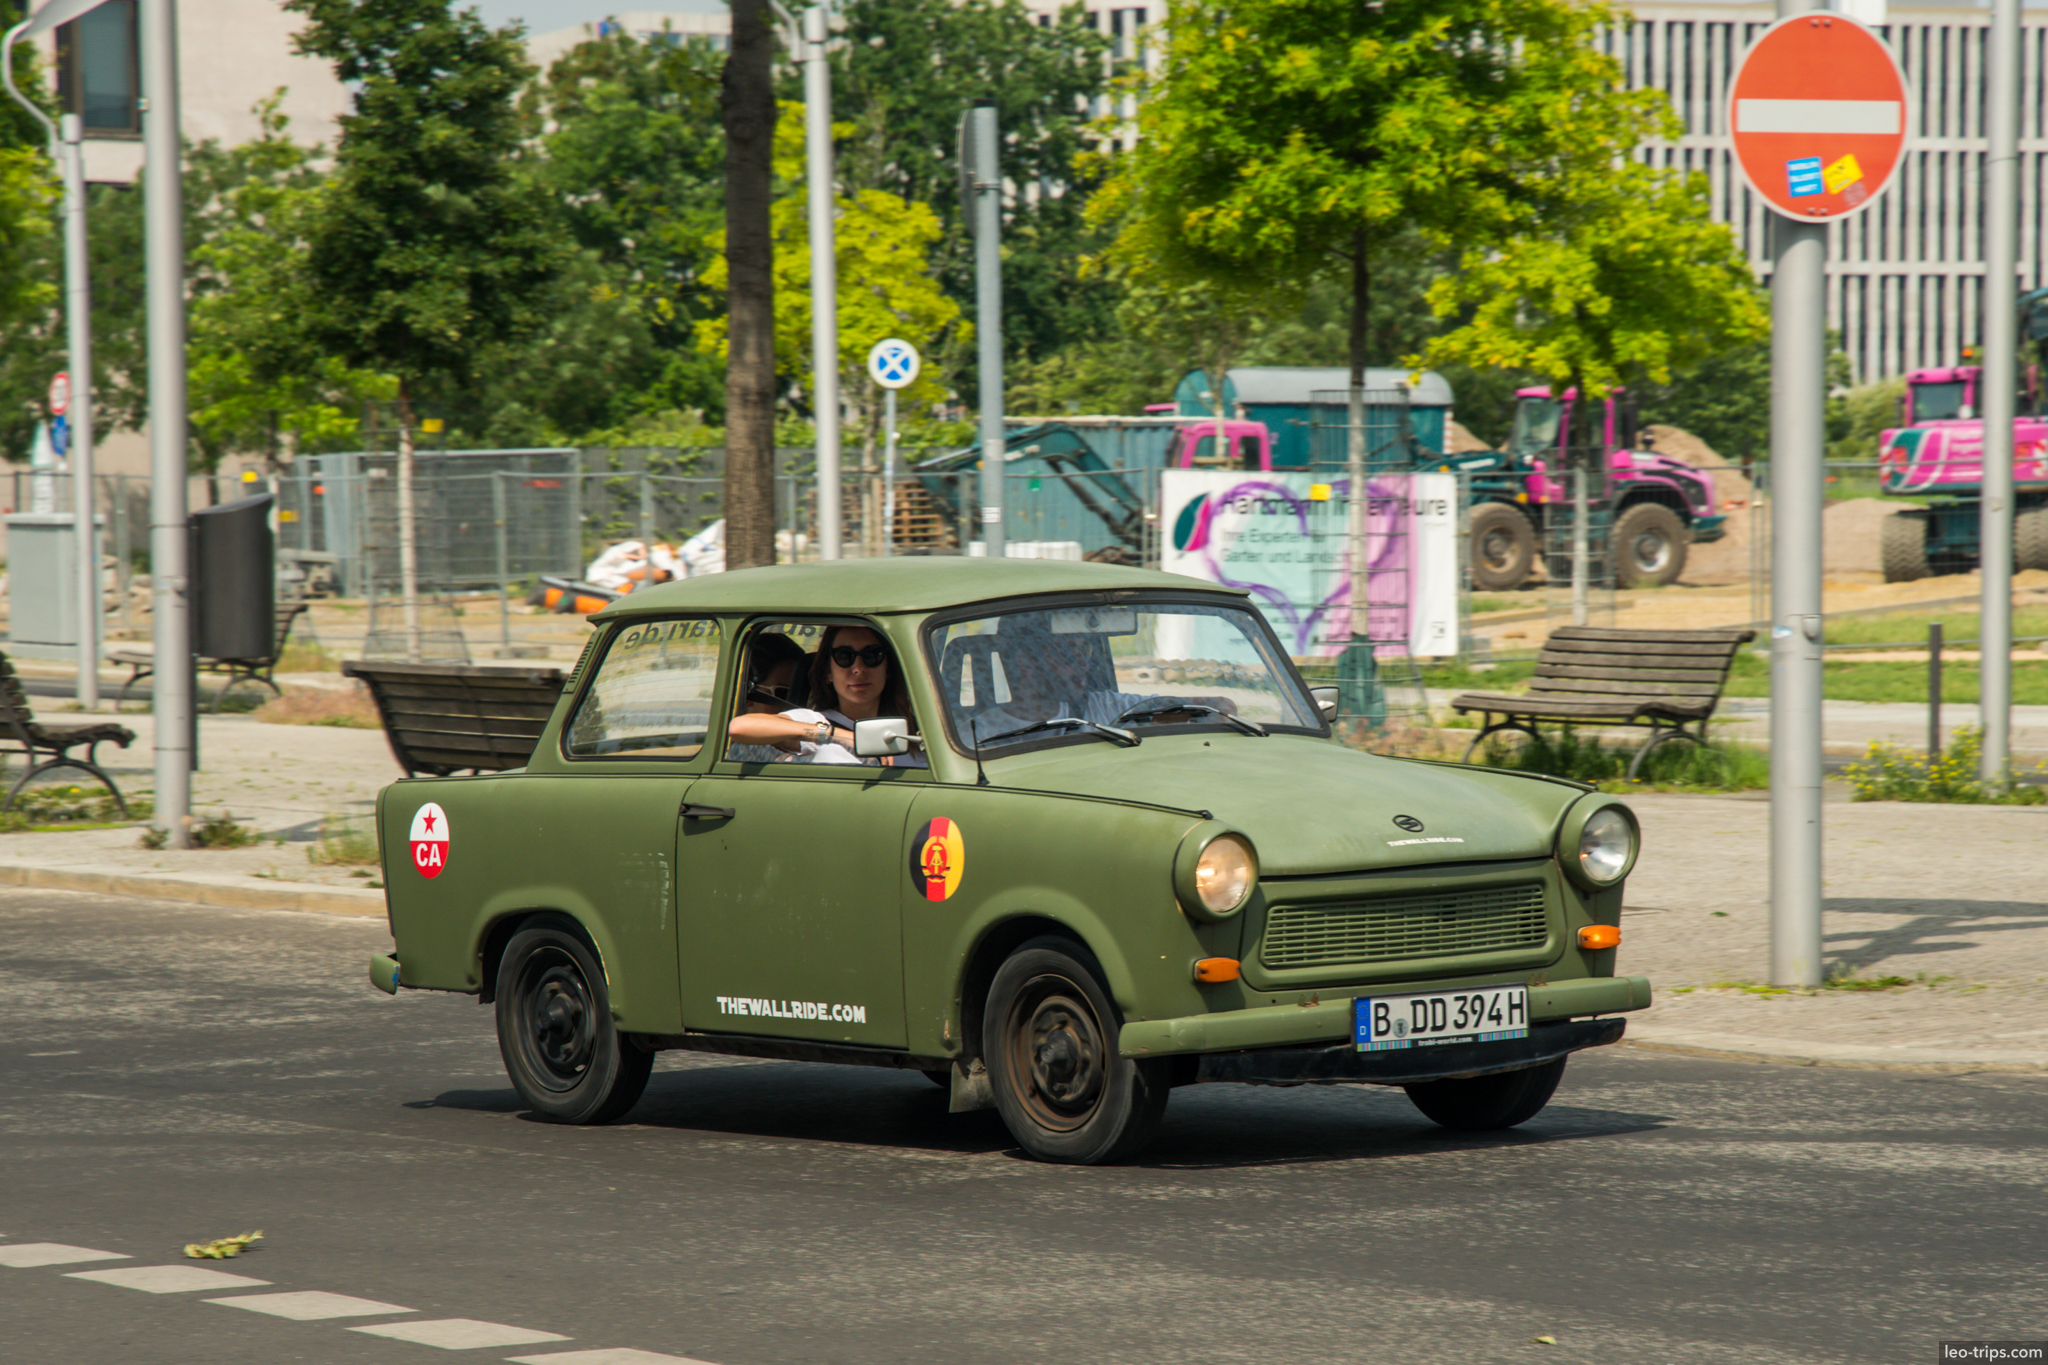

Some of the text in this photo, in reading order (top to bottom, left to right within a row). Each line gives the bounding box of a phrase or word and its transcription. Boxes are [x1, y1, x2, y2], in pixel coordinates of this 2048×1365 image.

[416, 843, 442, 867] CA
[716, 996, 867, 1024] THEWALLRIDE.COM
[1374, 1002, 1391, 1036] B
[1410, 997, 1446, 1034] DD
[1418, 1036, 1472, 1047] trabi-world.com
